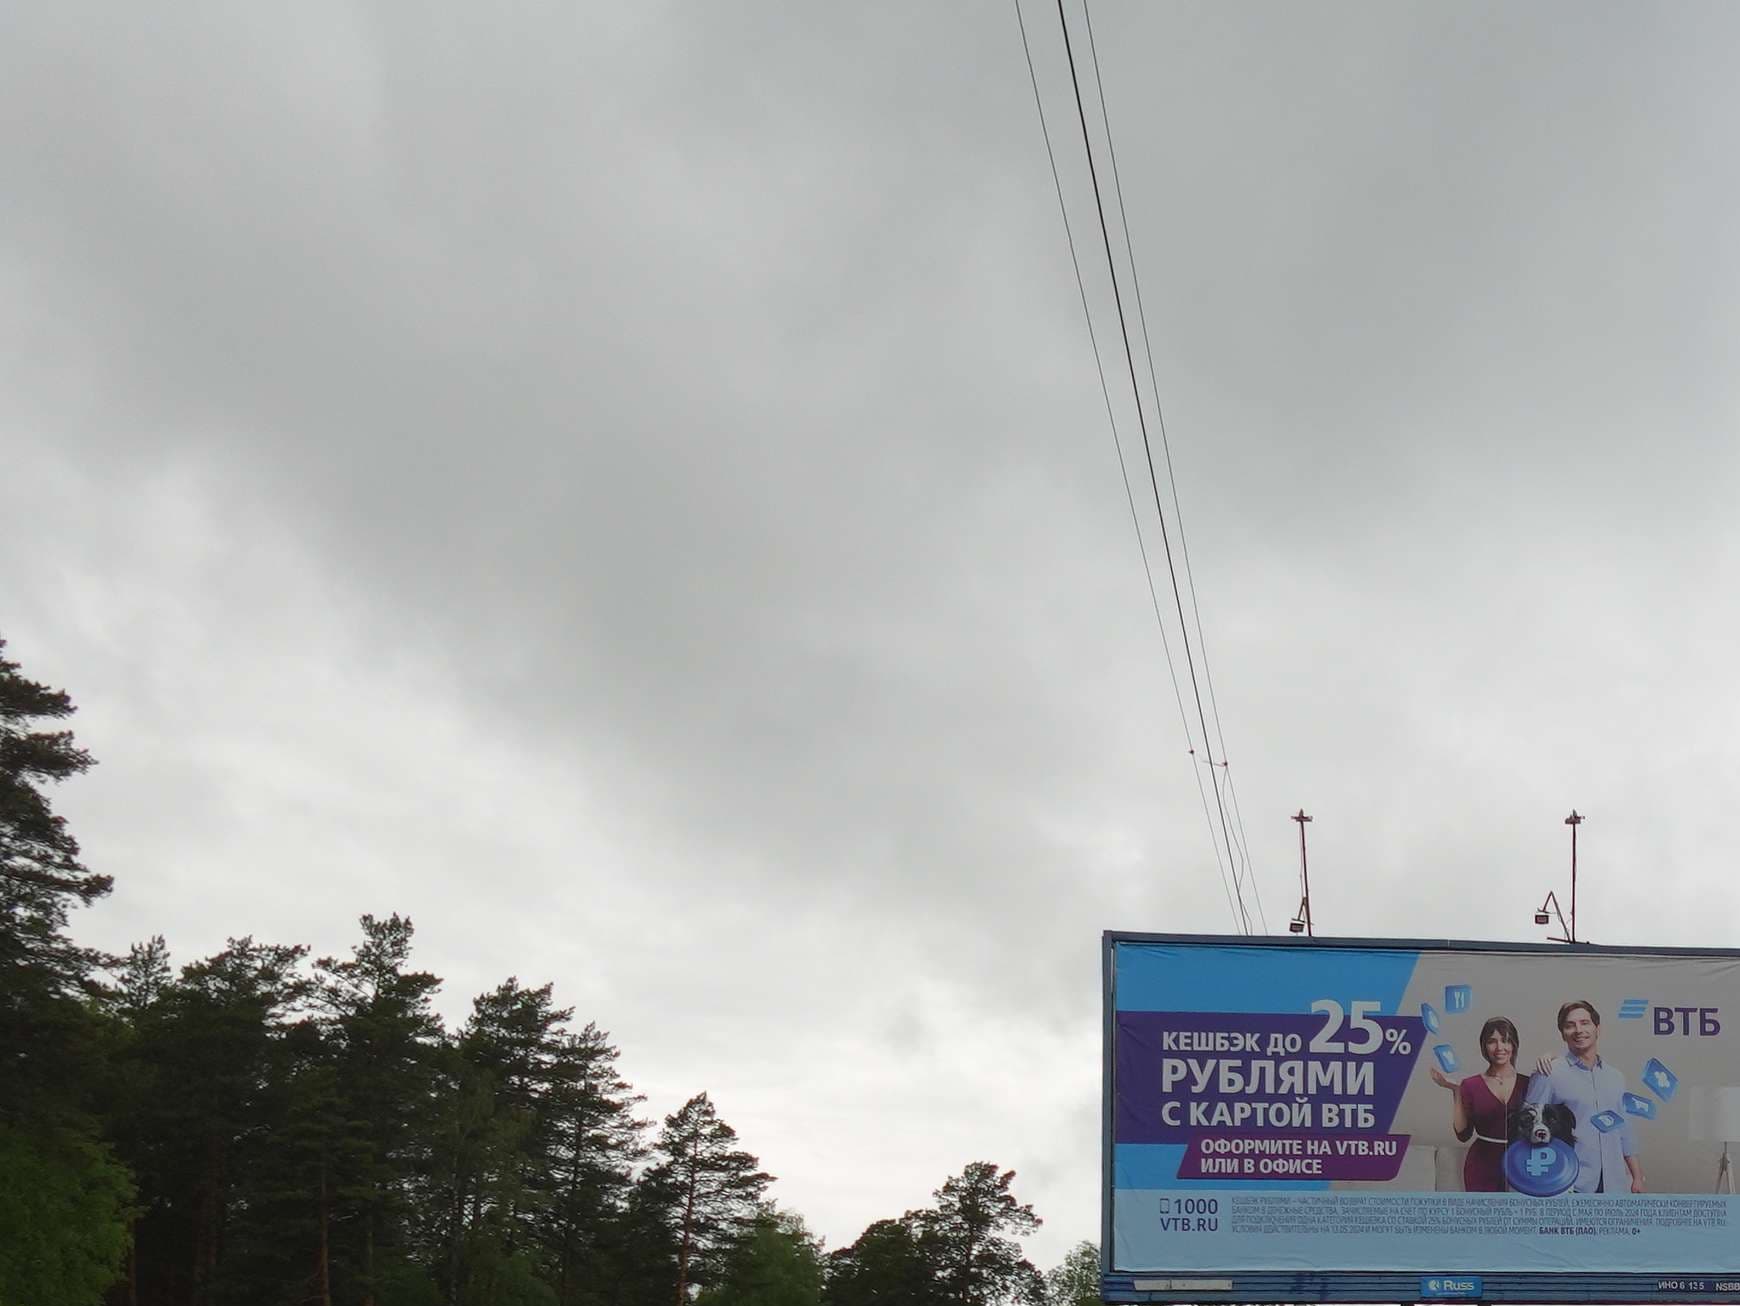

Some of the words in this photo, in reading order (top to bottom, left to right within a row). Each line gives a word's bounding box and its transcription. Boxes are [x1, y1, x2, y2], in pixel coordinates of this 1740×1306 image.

[1162, 1031, 1260, 1052] КЕШБЭК
[1266, 1033, 1302, 1056] ДО
[1309, 999, 1411, 1055] 25%
[1653, 1007, 1721, 1036] ВТБ
[1161, 1058, 1375, 1096] РУБЛЯМИ
[1161, 1101, 1181, 1126] С
[1189, 1096, 1312, 1128] КАРТОЙ
[1321, 1103, 1375, 1128] ВТБ
[1200, 1138, 1303, 1156] ОФОРМИТЕ
[1307, 1141, 1332, 1155] НА
[1335, 1141, 1397, 1156] VTB.RU
[1200, 1158, 1239, 1174] ИЛИ
[1243, 1159, 1254, 1173] В
[1259, 1158, 1322, 1174] ОФИСЕ
[1174, 1198, 1218, 1215] 1000
[1160, 1218, 1218, 1231] VTB.RU
[1444, 1280, 1474, 1291] Russ
